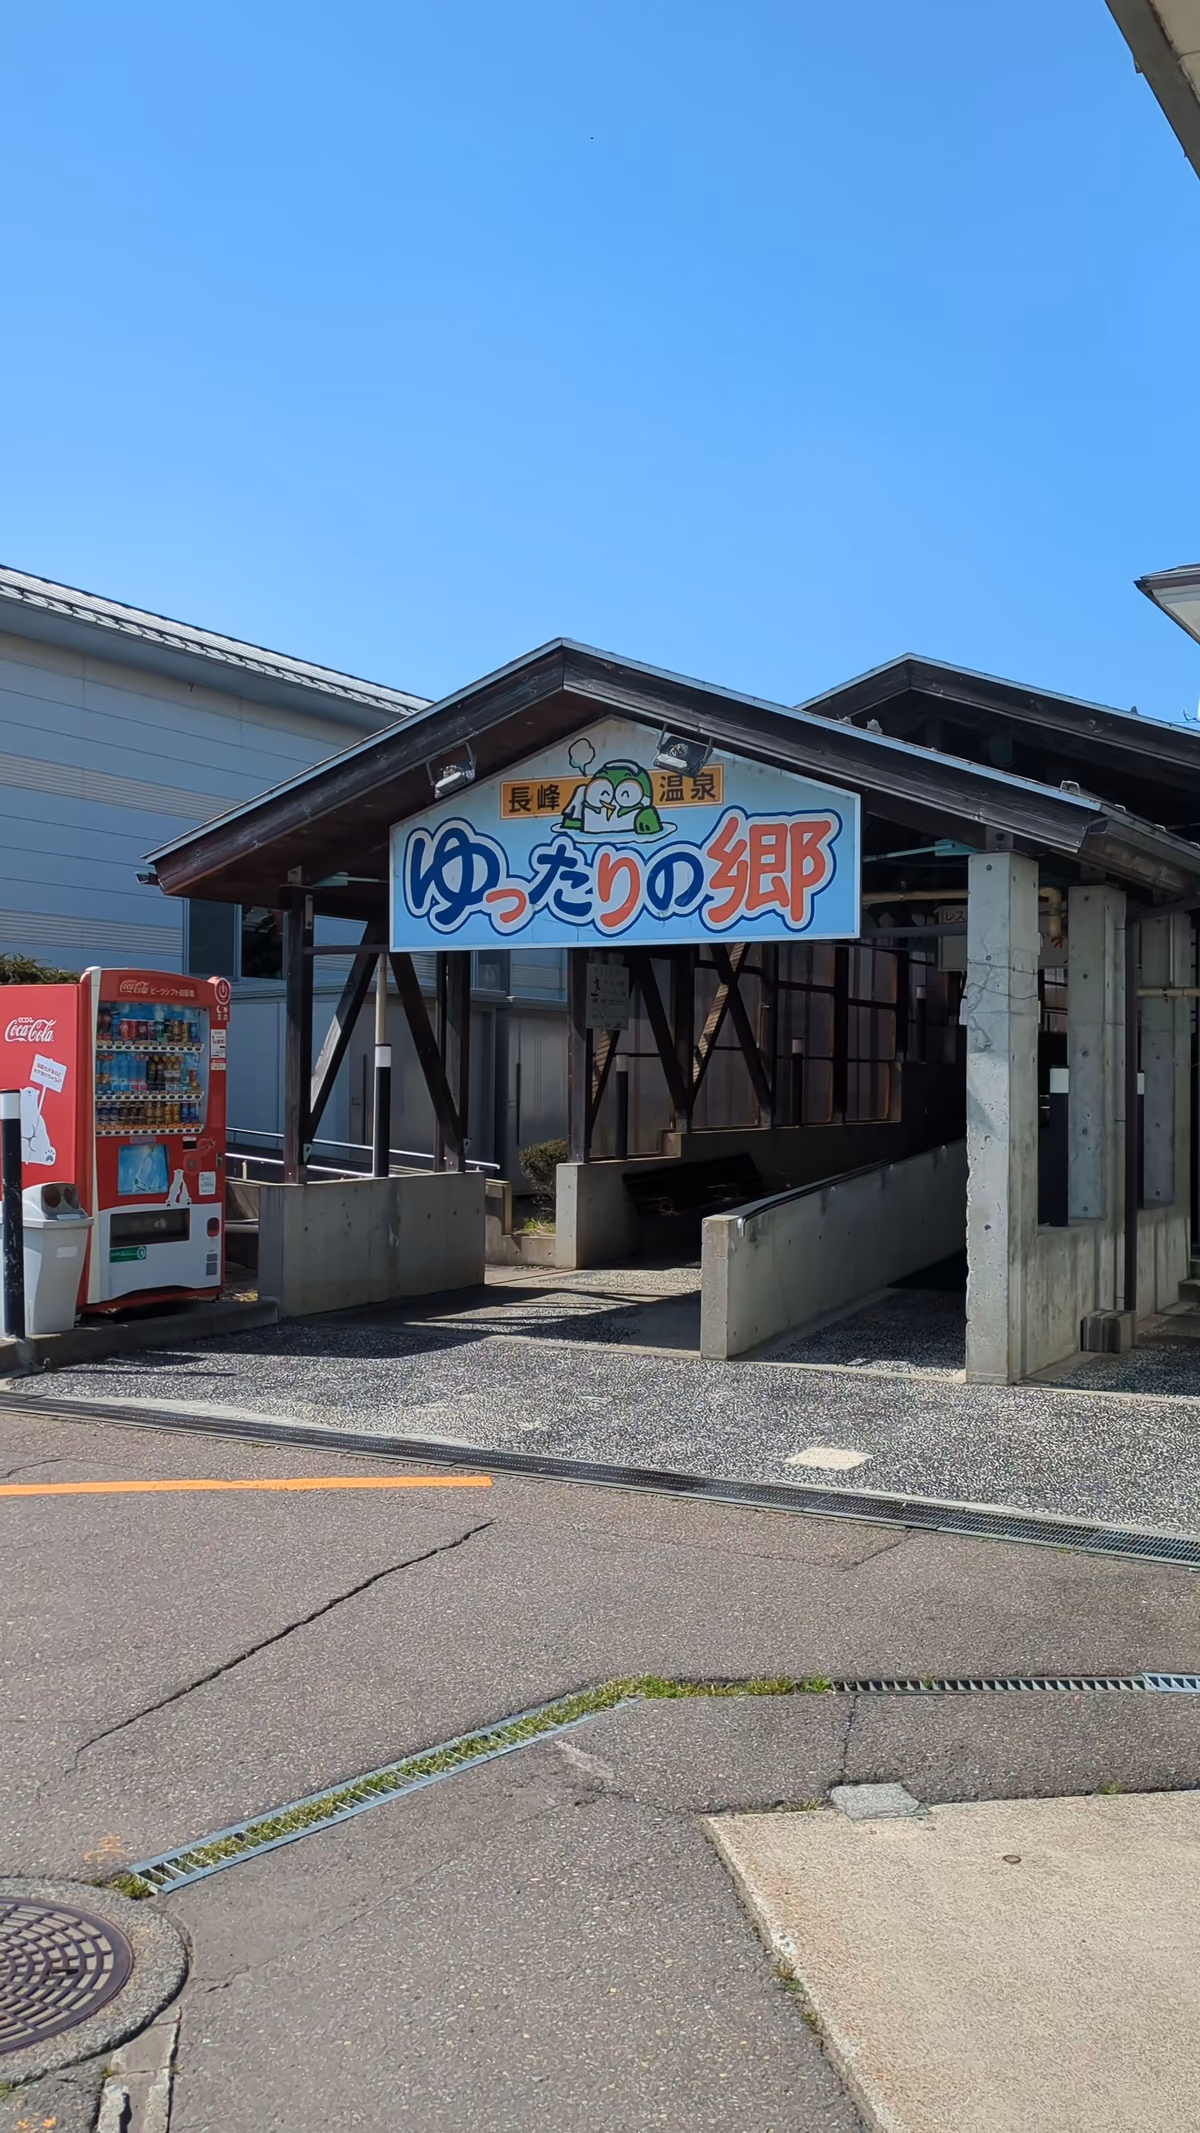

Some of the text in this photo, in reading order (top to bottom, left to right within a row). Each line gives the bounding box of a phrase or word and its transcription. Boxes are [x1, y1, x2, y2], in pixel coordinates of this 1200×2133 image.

[507, 775, 717, 813] 長峰 温泉
[408, 814, 834, 928] ゆったりの郷
[5, 1019, 57, 1042] Coca-Cola
